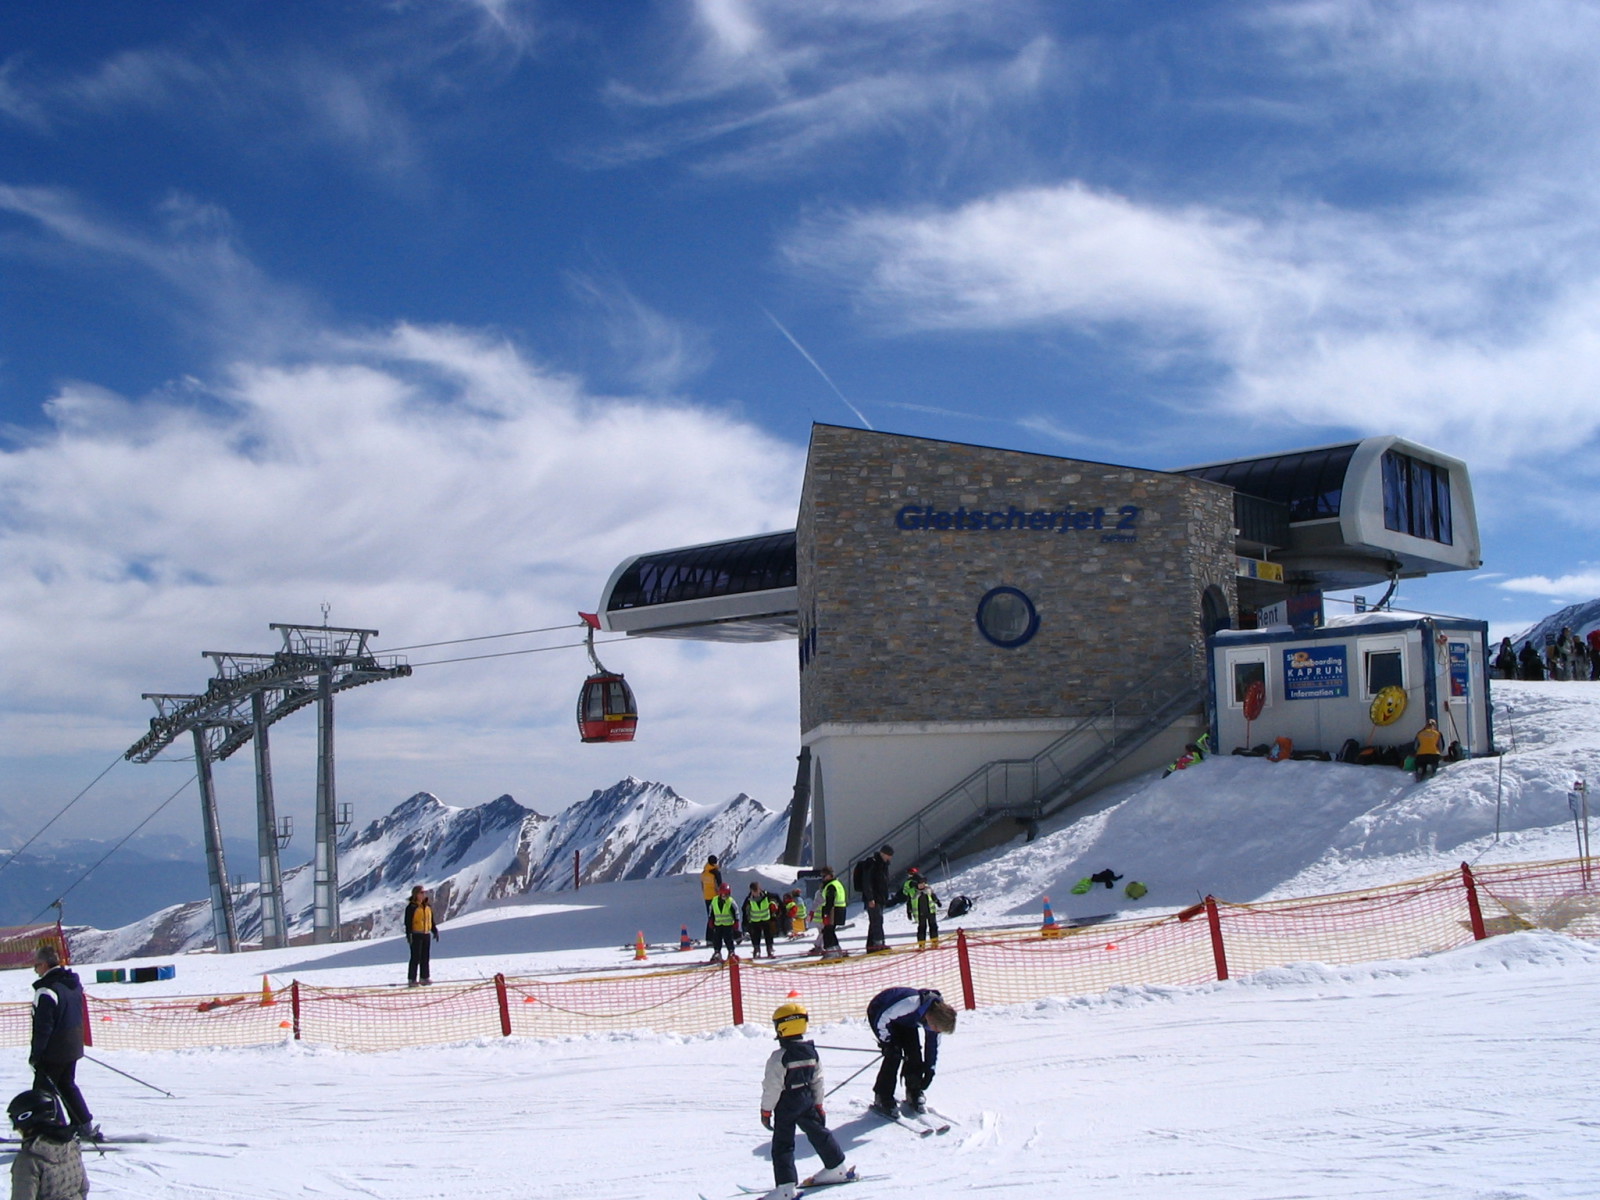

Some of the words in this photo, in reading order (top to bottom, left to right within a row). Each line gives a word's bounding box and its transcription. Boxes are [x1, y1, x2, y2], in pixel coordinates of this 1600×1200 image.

[896, 505, 1104, 533] Gletscherjet
[1116, 504, 1137, 529] 2
[1258, 607, 1279, 626] Rent
[1288, 666, 1342, 677] KAPRUN
[1291, 689, 1334, 698] Information
